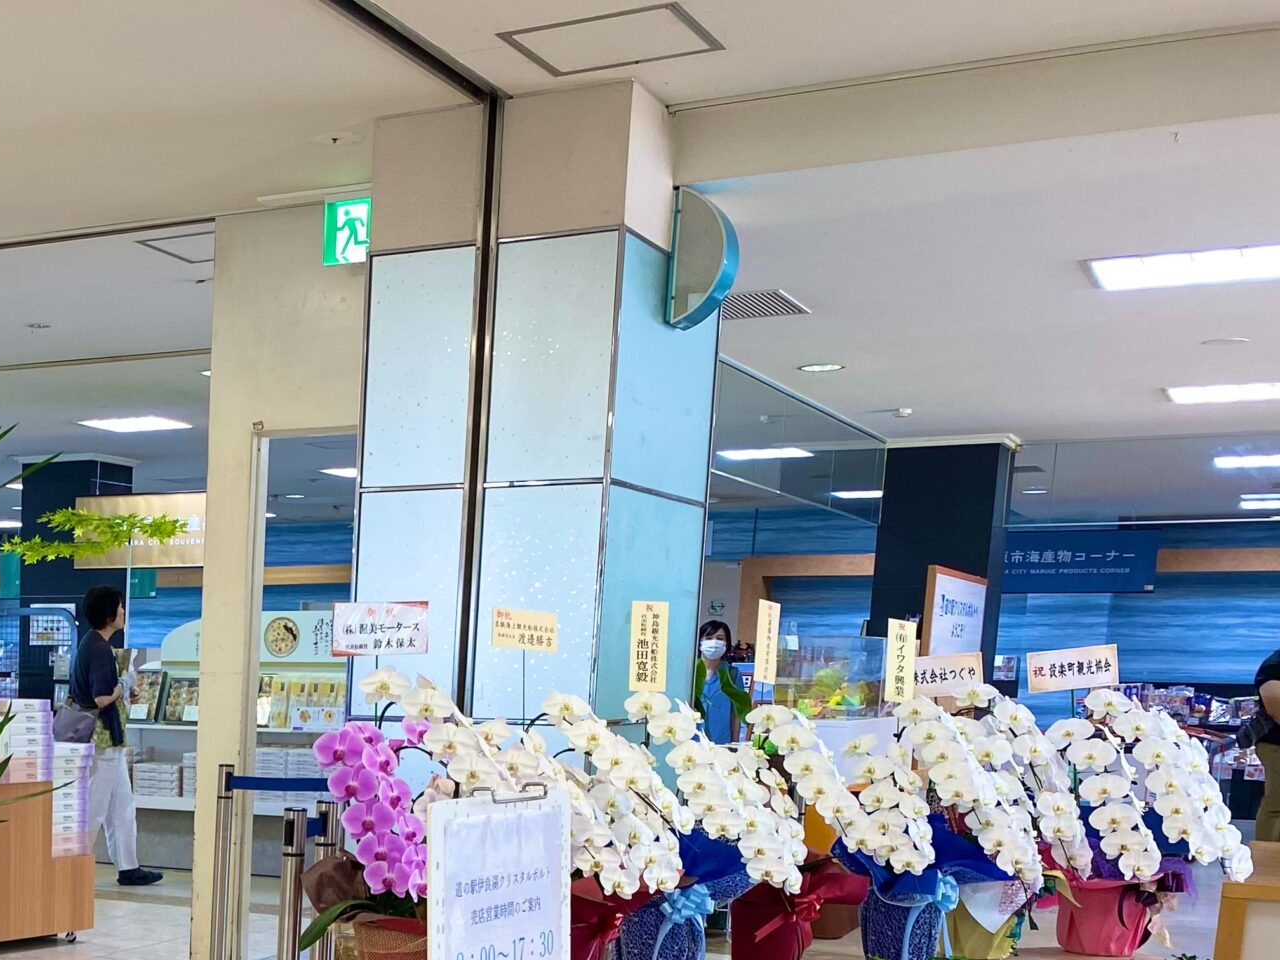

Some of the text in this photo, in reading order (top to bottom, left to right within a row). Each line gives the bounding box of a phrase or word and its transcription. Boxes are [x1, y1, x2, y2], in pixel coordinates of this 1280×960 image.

[1032, 666, 1047, 679] 祝
[471, 895, 541, 926] 売店営業時間のご案内
